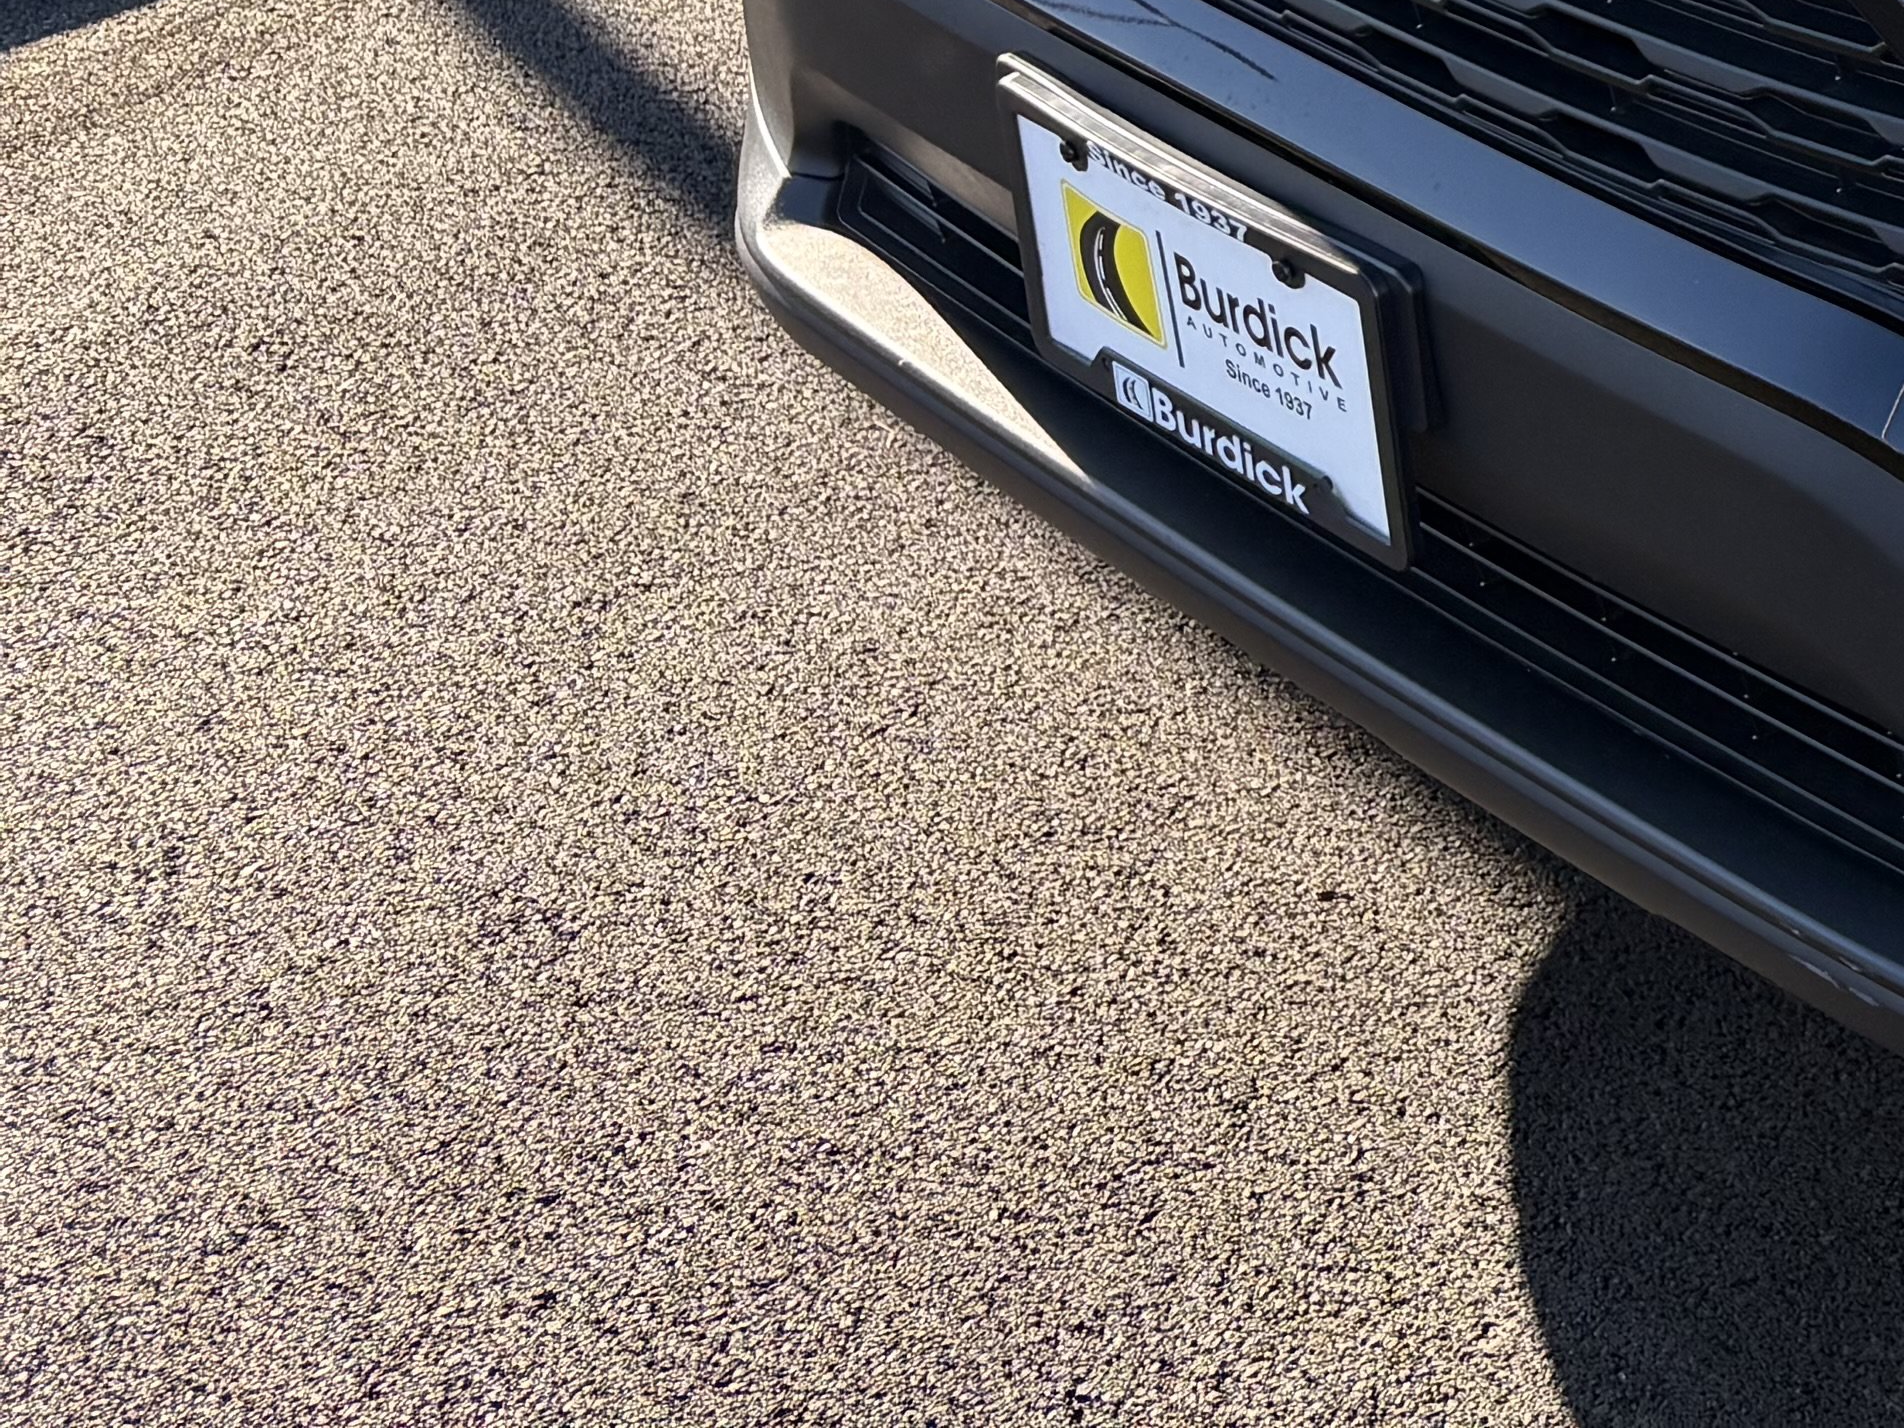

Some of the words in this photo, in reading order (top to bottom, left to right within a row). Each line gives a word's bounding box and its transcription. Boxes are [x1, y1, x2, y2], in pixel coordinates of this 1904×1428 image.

[1087, 145, 1166, 203] Since
[1174, 191, 1248, 243] 1937
[1174, 251, 1343, 390] Burdick
[1186, 316, 1348, 413] AUTOMOTIVE
[1226, 359, 1271, 399] Since
[1275, 387, 1313, 421] 1937
[1152, 387, 1311, 515] Burdick
